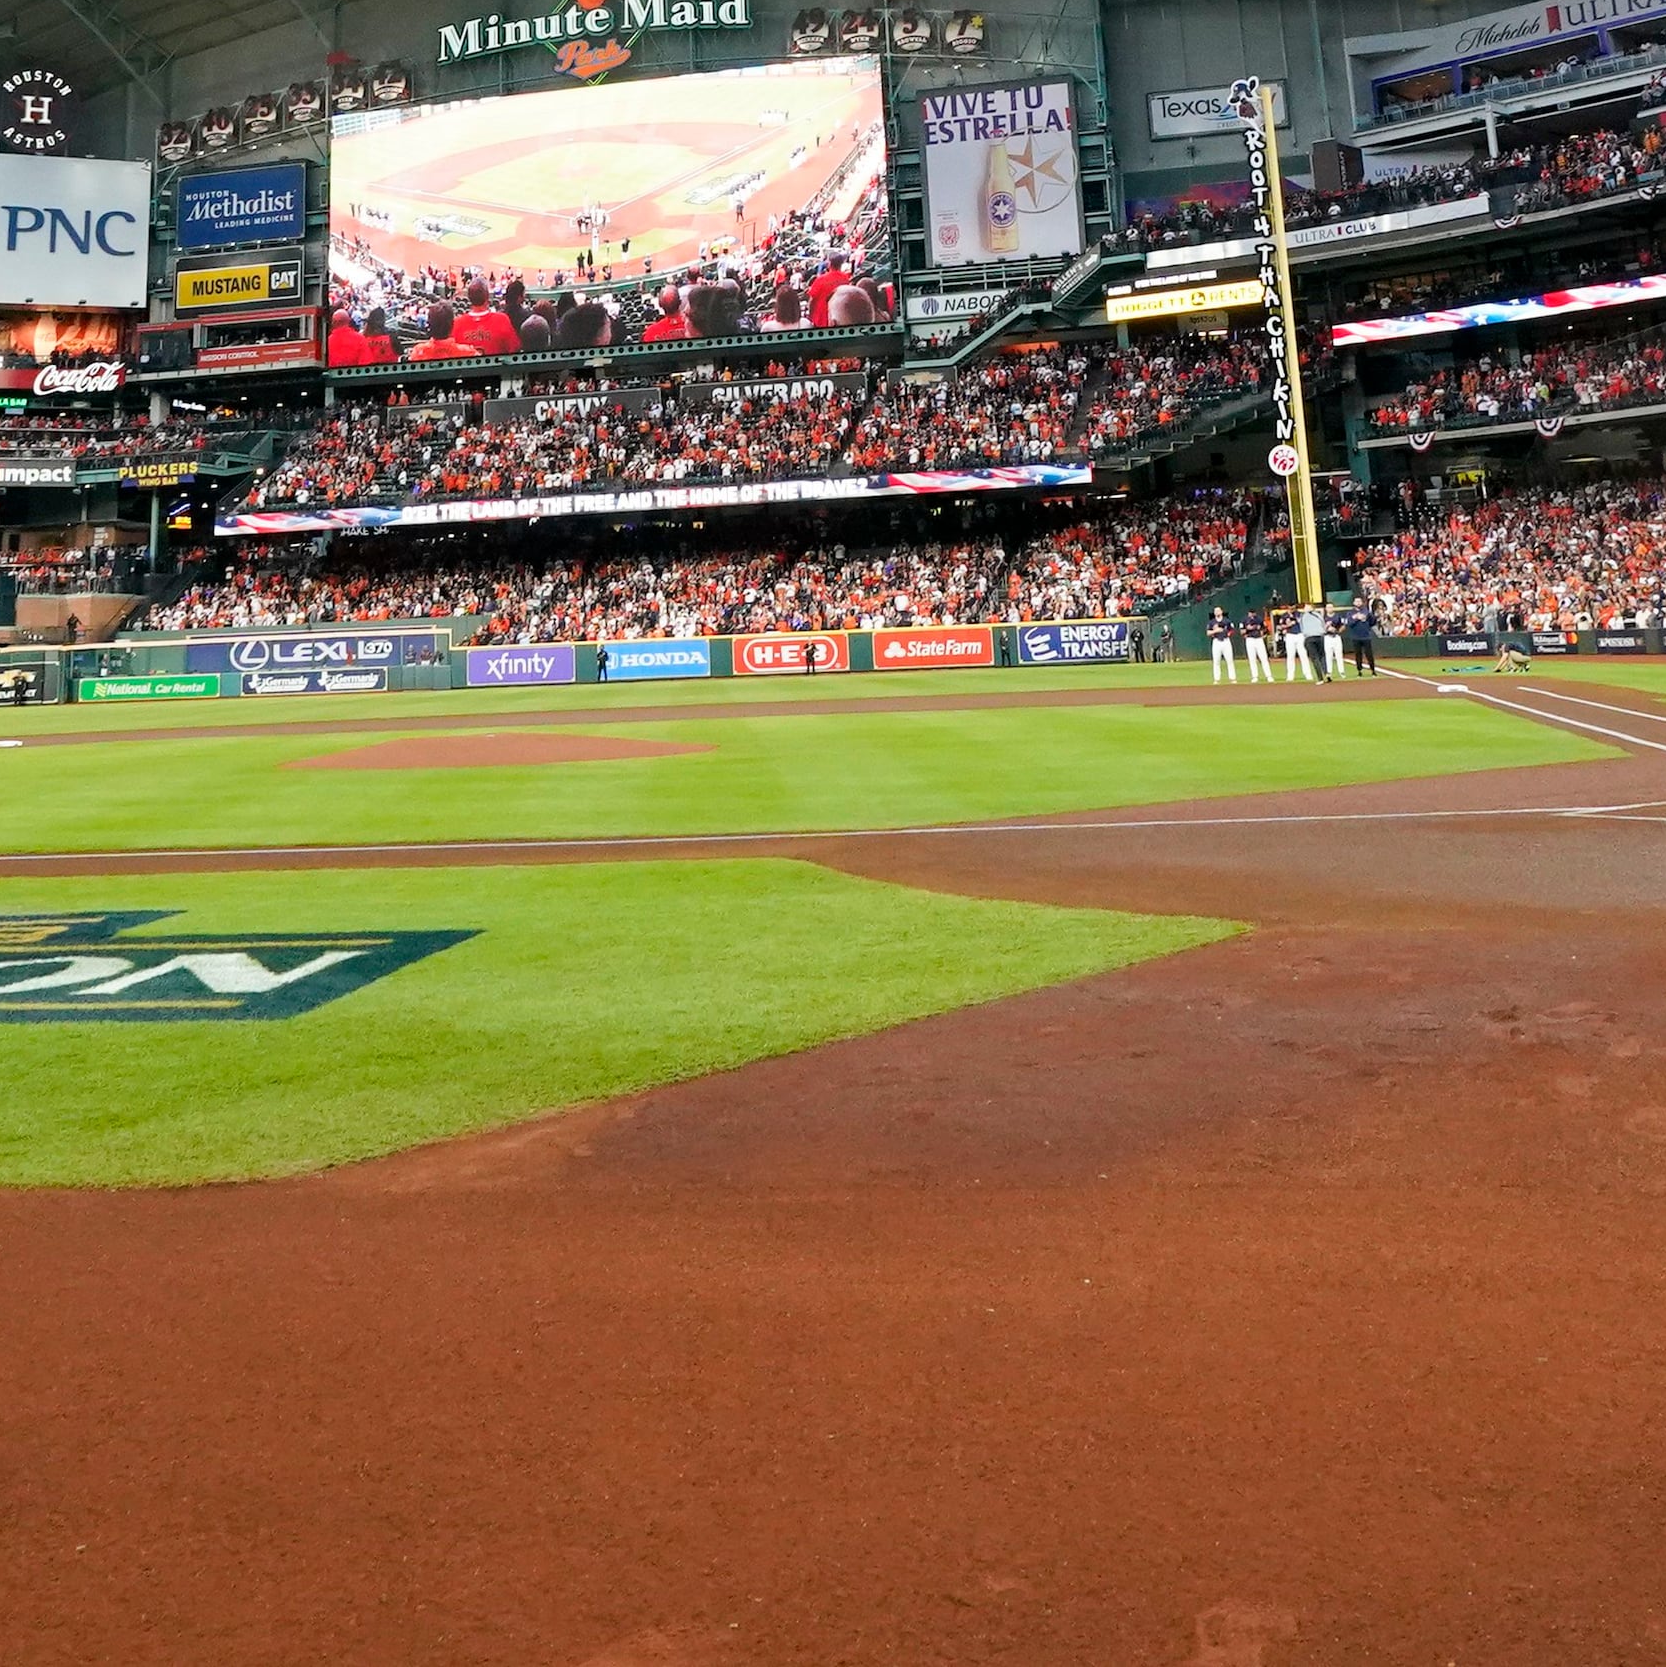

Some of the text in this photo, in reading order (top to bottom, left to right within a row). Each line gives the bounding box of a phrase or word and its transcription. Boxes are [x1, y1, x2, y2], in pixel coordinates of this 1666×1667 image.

[437, 3, 611, 63] Minute
[1455, 15, 1542, 54] Michelob
[555, 39, 631, 75] Park
[3, 70, 73, 97] HOUSTON
[20, 95, 54, 125] H
[1009, 86, 1044, 110] TU
[1158, 95, 1223, 119] Texas
[3, 126, 67, 150] ASTROS
[925, 107, 1074, 145] ESTRELLA!
[1244, 130, 1265, 208] ROOT
[1375, 166, 1409, 178] ULTRA
[185, 189, 230, 202] HOUSTON
[186, 189, 295, 222] Methodist
[1, 205, 137, 257] PNC
[214, 213, 295, 230] LEADING MEDICINE
[1253, 216, 1271, 239] 4
[1294, 222, 1377, 245] ULTRA CLUB
[192, 271, 297, 297] MUSTANG CAT
[1209, 286, 1259, 307] RENTS
[33, 361, 125, 396] Coca-Cola
[1265, 315, 1296, 440] CHIKIN
[118, 462, 200, 479] PLUCKERS
[163, 476, 179, 486] BAR
[437, 503, 470, 520] THE
[473, 500, 516, 520] LAND
[517, 498, 540, 516] OF
[541, 496, 573, 515] THE
[575, 492, 615, 512] FREE
[616, 490, 656, 510] AND
[656, 488, 689, 508] THE
[690, 486, 738, 506] HOME
[740, 484, 764, 503] OF
[766, 482, 800, 501] THE
[801, 477, 869, 499] BRAVE?
[1061, 625, 1120, 641] ENERGY
[1446, 639, 1488, 653] Booking.com
[486, 652, 556, 681] xfinity
[620, 650, 709, 667] HONDA
[106, 682, 206, 696] National Car Rental
